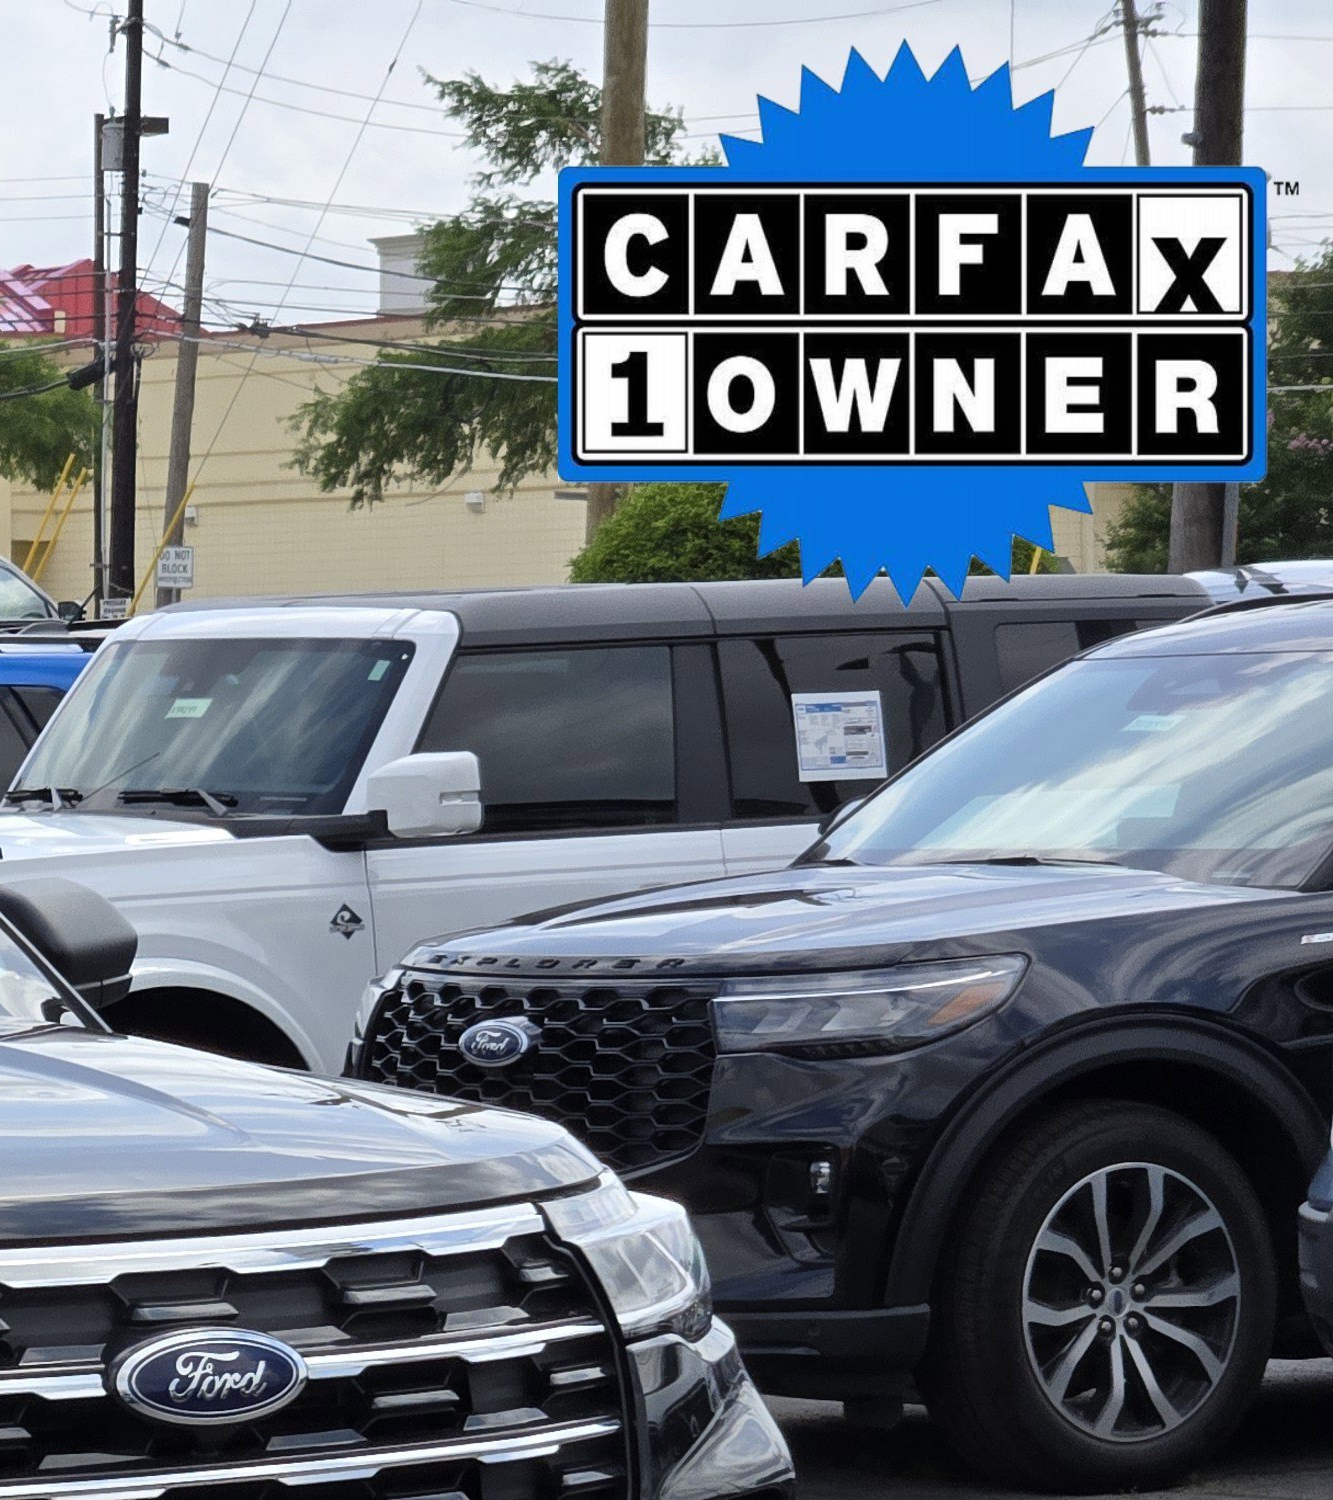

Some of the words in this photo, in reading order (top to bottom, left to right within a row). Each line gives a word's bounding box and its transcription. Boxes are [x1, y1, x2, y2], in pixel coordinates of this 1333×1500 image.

[174, 550, 190, 561] NOT
[161, 563, 188, 574] BLOCK
[427, 954, 686, 970] EXPLORER
[470, 1030, 510, 1054] Ford
[168, 1350, 268, 1403] Ford
